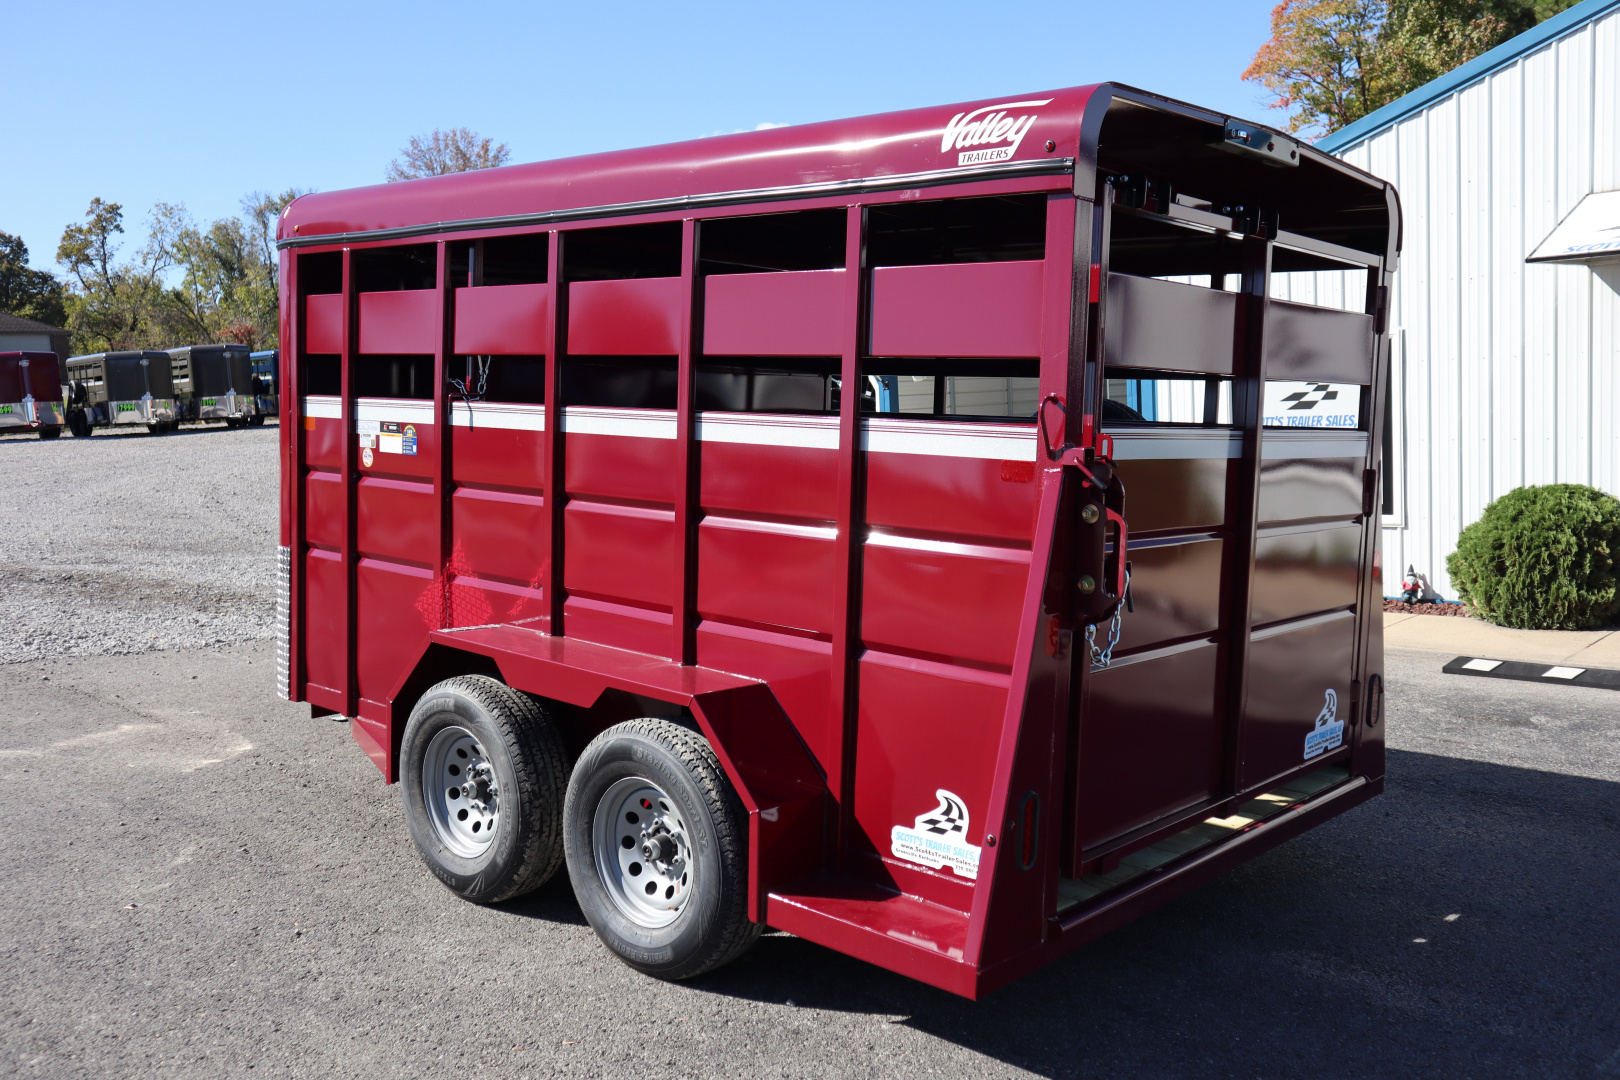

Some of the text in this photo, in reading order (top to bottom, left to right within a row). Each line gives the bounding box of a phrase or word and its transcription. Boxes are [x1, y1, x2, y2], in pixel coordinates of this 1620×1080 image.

[941, 98, 1054, 153] Valley
[961, 148, 1010, 164] TRAILERS
[1286, 415, 1323, 428] TRAILER
[1325, 414, 1358, 428] SALES,
[895, 831, 924, 847] SCOTT'S
[924, 838, 952, 854] TRAILER
[952, 846, 976, 862] SALES,
